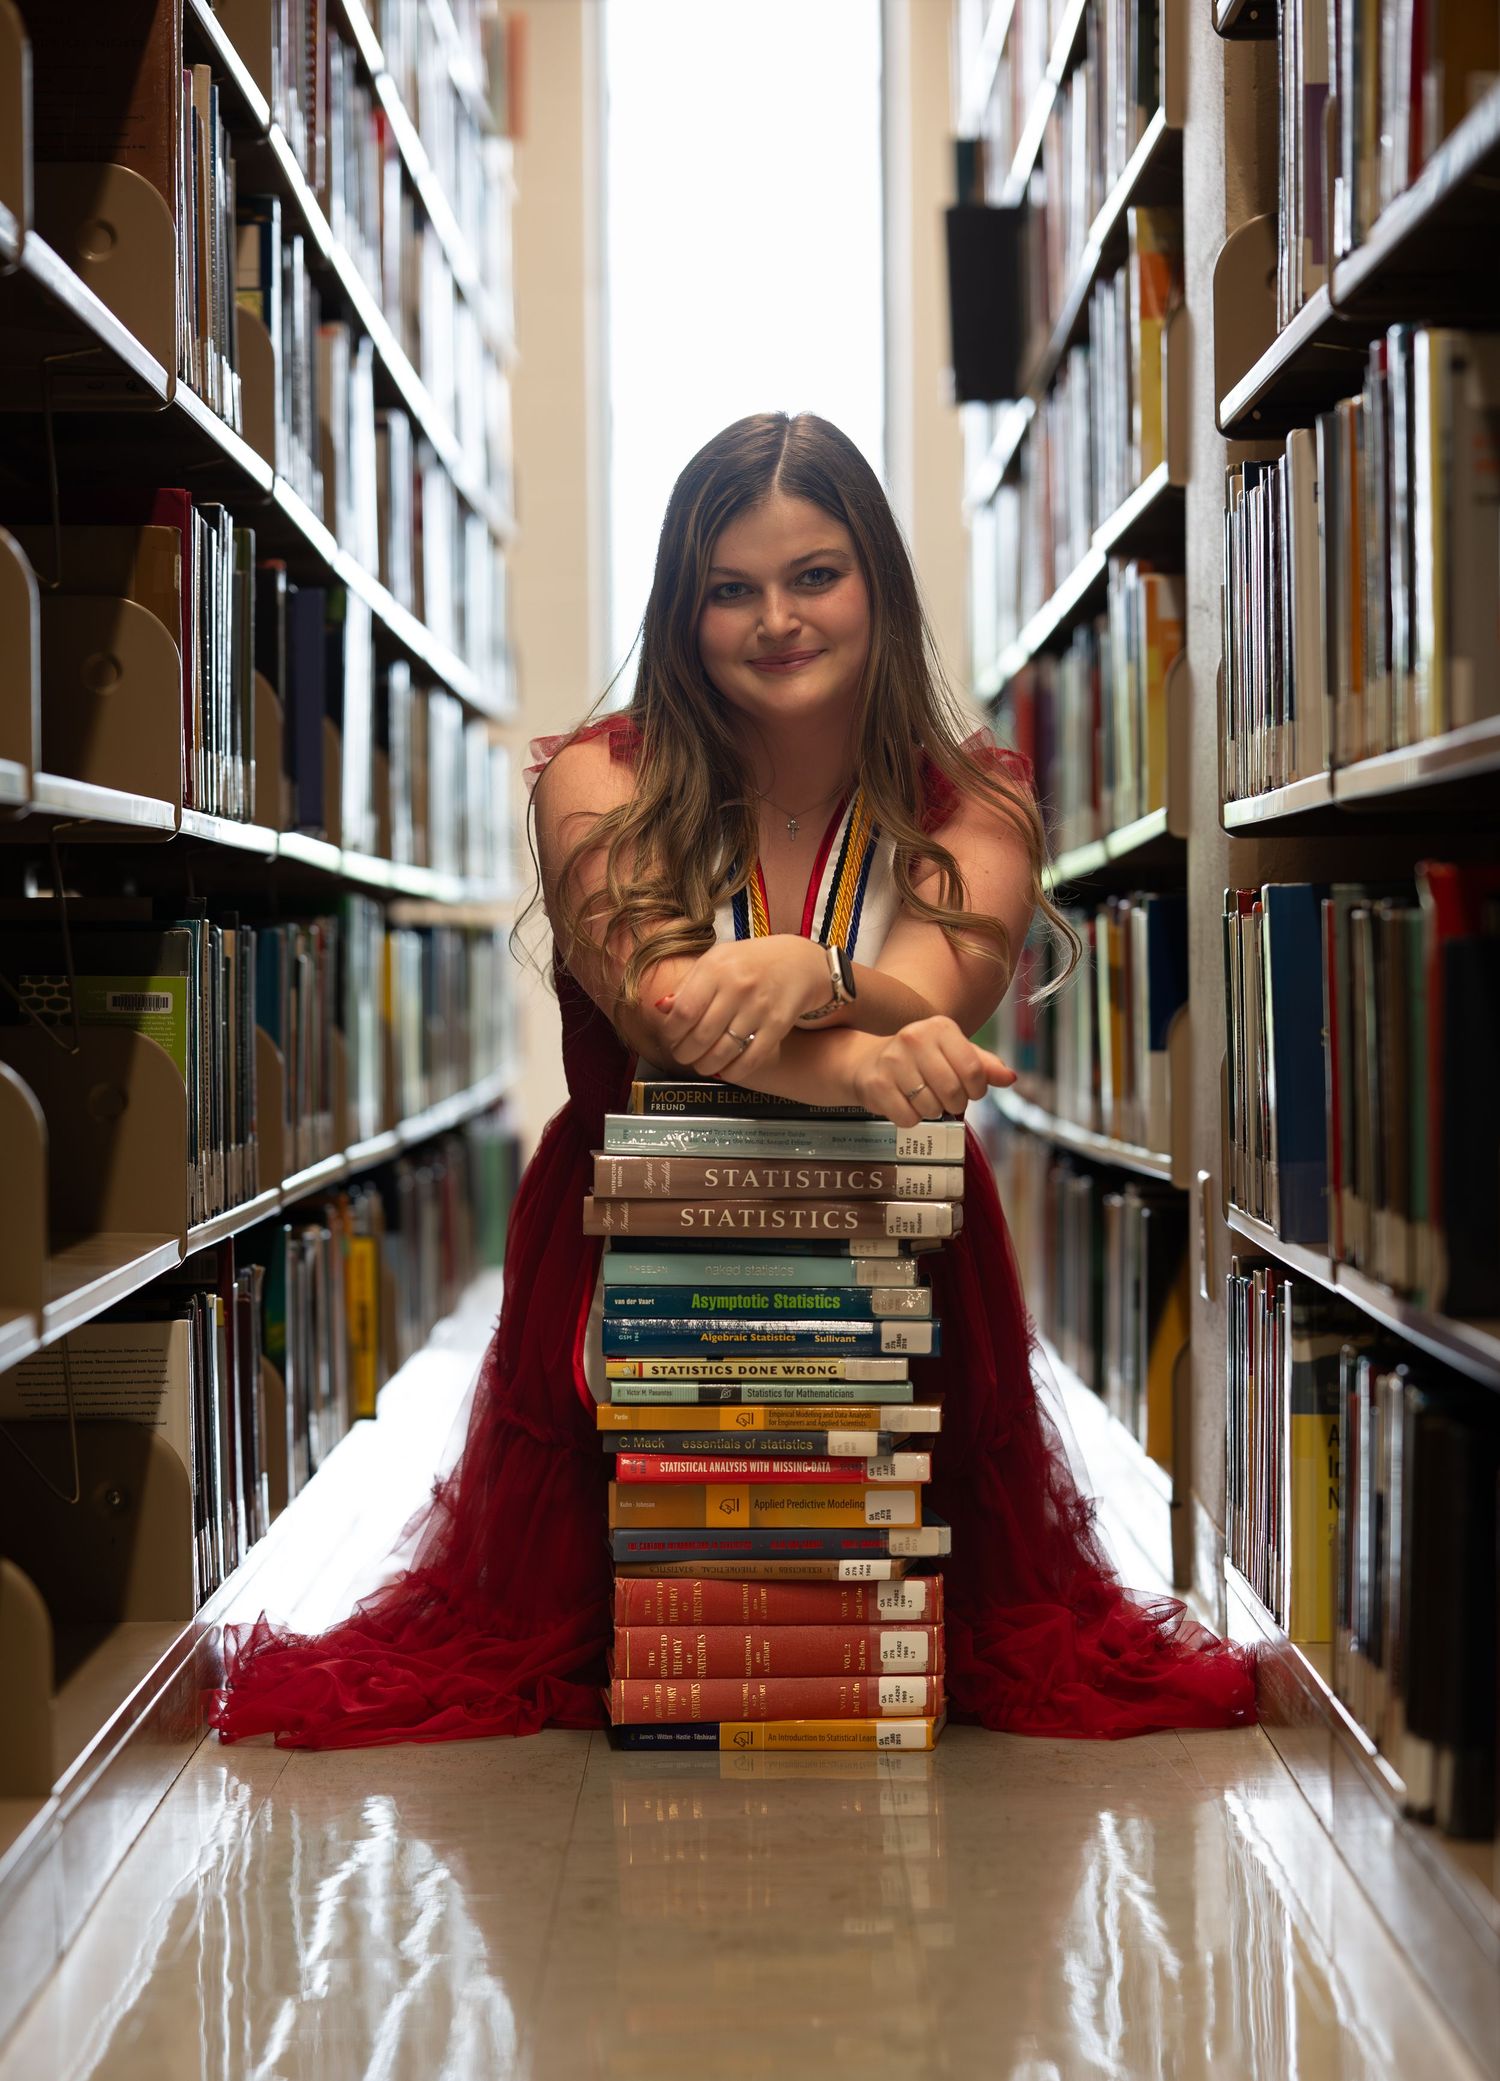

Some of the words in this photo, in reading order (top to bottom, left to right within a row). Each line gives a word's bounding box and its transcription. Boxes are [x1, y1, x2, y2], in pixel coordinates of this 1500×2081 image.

[651, 1090, 713, 1104] MODERN
[651, 1103, 686, 1111] FREUND
[660, 1160, 671, 1196] Franklin
[704, 1168, 884, 1191] STATISTICS
[680, 1207, 860, 1230] STATISTICS
[705, 1263, 742, 1276] naked
[745, 1263, 795, 1277] statistics
[630, 1297, 642, 1305] der
[643, 1297, 655, 1305] Vaart
[691, 1293, 770, 1312] Asymptotic
[774, 1293, 841, 1309] Statistics
[701, 1332, 747, 1343] Algebraic
[750, 1332, 797, 1343] Statistics
[814, 1333, 857, 1344] Sullivant
[651, 1365, 733, 1375] STATISTICS
[738, 1365, 777, 1375] DONE
[782, 1365, 838, 1376] WRONG
[747, 1389, 780, 1399] Statistics
[783, 1389, 794, 1398] for
[795, 1389, 854, 1399] Mathematicians
[619, 1437, 632, 1448] C.
[633, 1437, 665, 1448] Mack
[682, 1438, 740, 1450] essentials
[744, 1438, 756, 1450] of
[760, 1439, 814, 1451] statistics
[659, 1461, 708, 1473] STATISTICAL
[709, 1461, 748, 1474] ANALYSIS
[750, 1461, 770, 1474] WITH
[772, 1462, 808, 1474] MISSING
[812, 1462, 831, 1473] DATA
[869, 1467, 875, 1476] QA
[754, 1498, 784, 1512] Applied
[786, 1498, 826, 1511] Predictive
[827, 1498, 865, 1512] Modeling
[868, 1513, 874, 1521] QA
[649, 1565, 694, 1575] STATISTICS
[764, 1565, 774, 1574] IN
[845, 1567, 850, 1576] QA
[669, 1586, 678, 1622] THEORY
[880, 1599, 885, 1608] QA
[660, 1634, 668, 1679] ADVANCED
[672, 1638, 682, 1676] THEORY
[686, 1652, 693, 1664] OF
[697, 1633, 706, 1679] STATISTICS
[883, 1650, 888, 1659] QA
[654, 1683, 662, 1718] ADVANCED
[667, 1686, 677, 1716] THEORY
[691, 1683, 701, 1719] STATISTICS
[881, 1695, 887, 1704] QA
[768, 1733, 777, 1742] An
[778, 1733, 817, 1742] Introduction
[818, 1734, 826, 1742] to
[826, 1733, 858, 1742] Statistical
